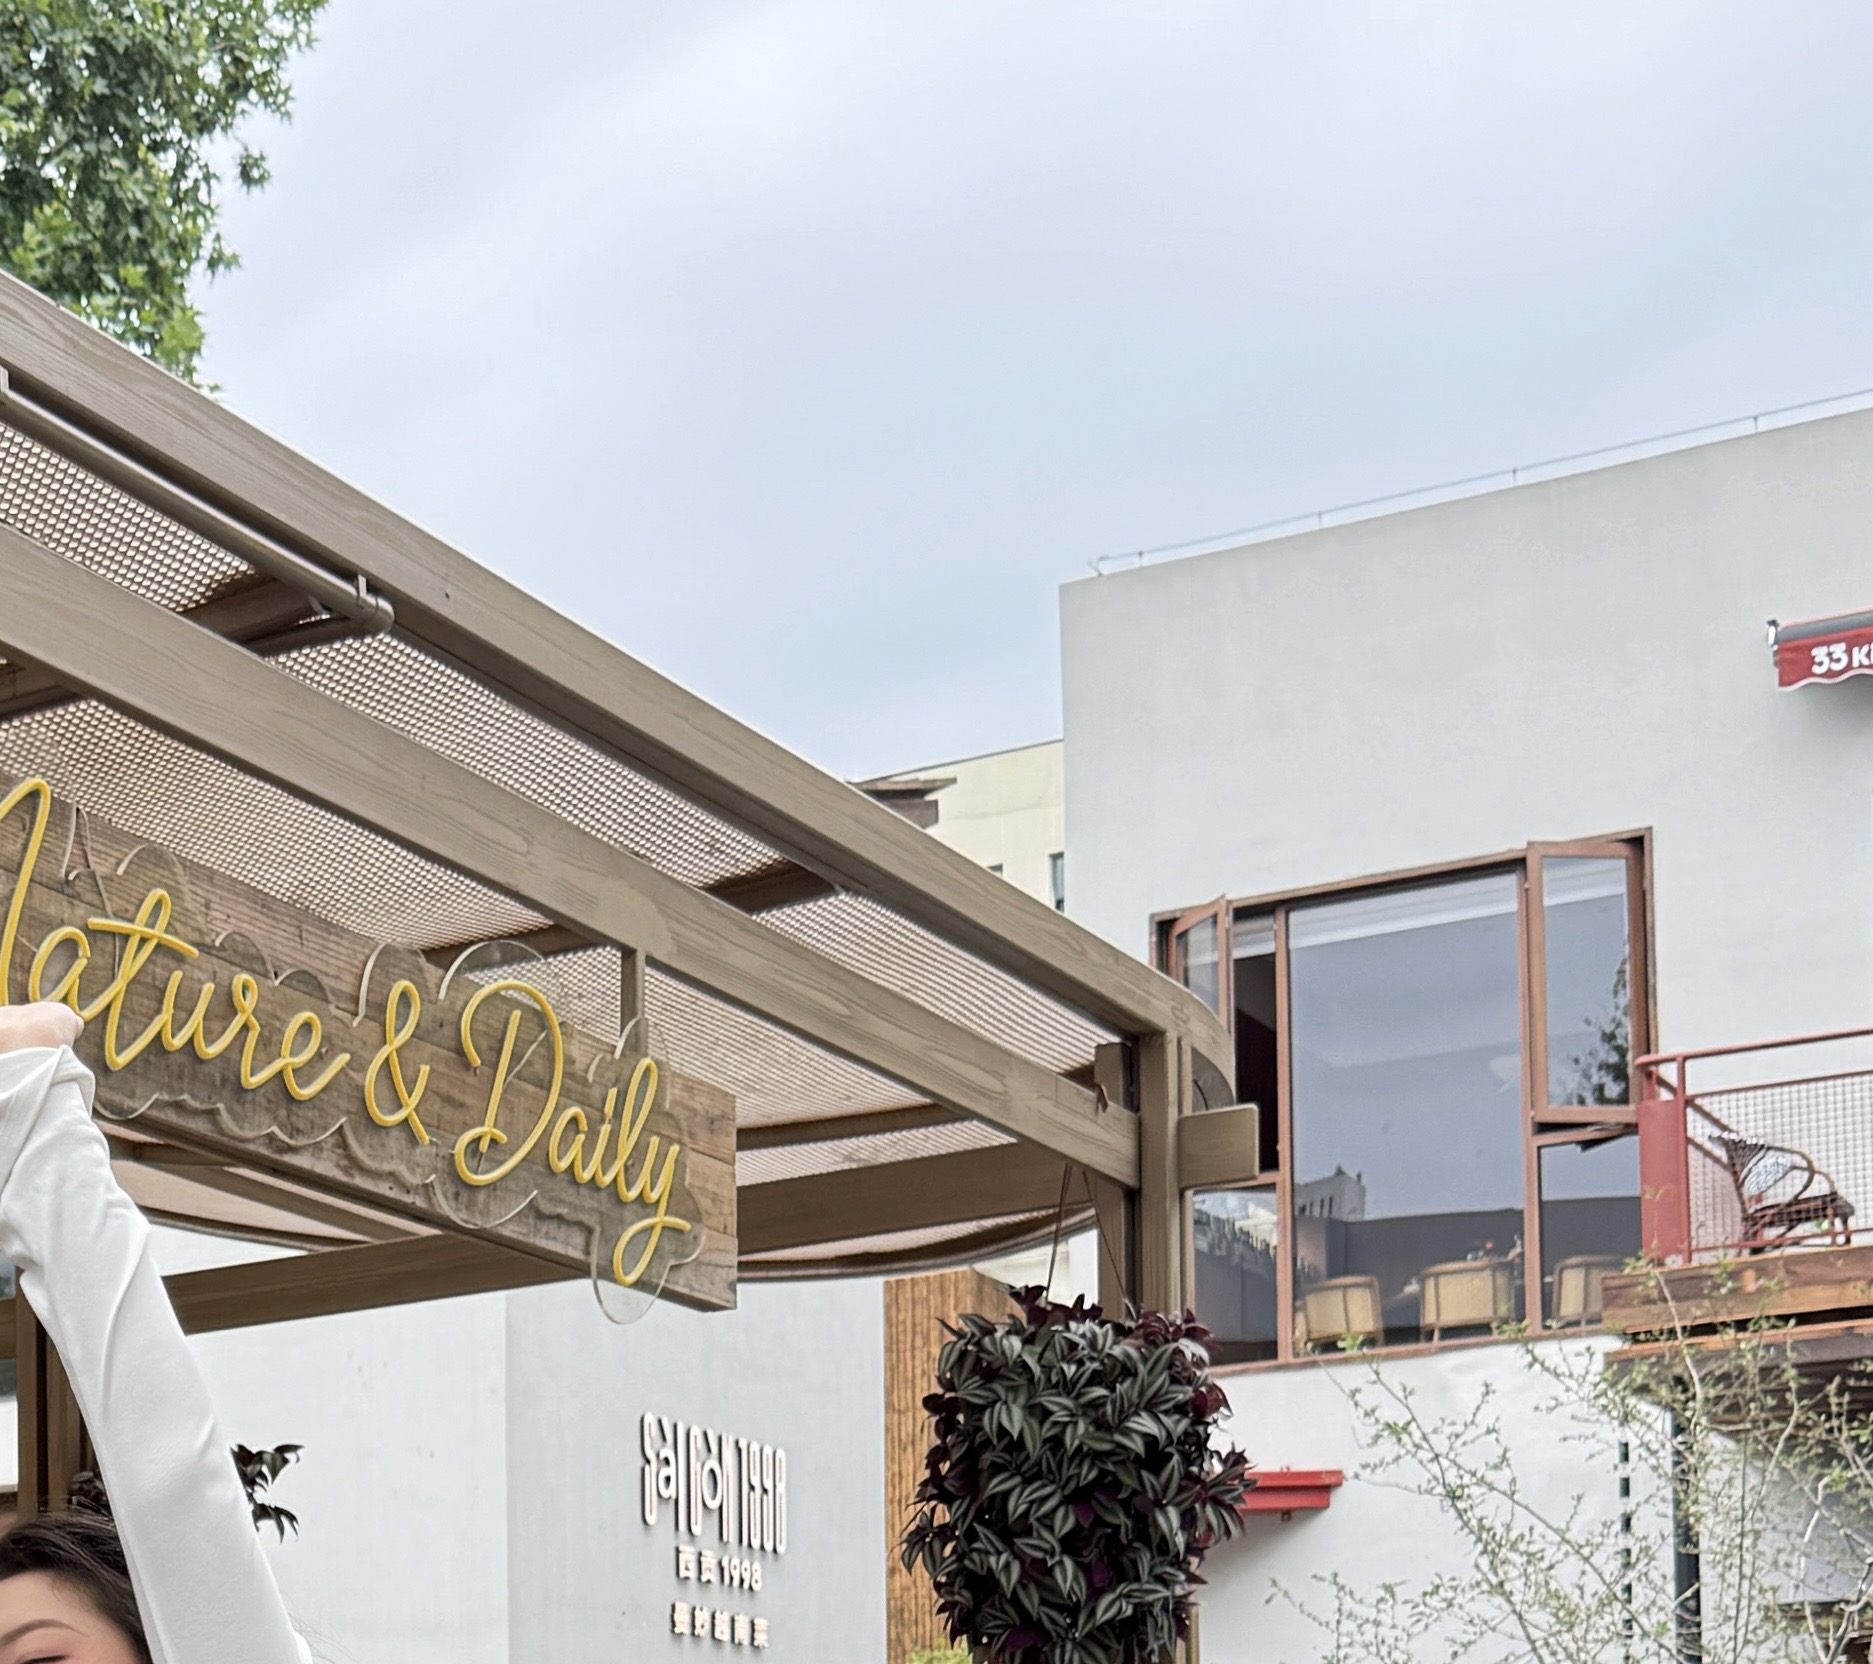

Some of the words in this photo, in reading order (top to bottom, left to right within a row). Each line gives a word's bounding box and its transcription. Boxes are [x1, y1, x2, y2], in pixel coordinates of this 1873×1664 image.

[1810, 642, 1849, 675] 33
[364, 978, 433, 1146] &
[454, 977, 692, 1288] Daily
